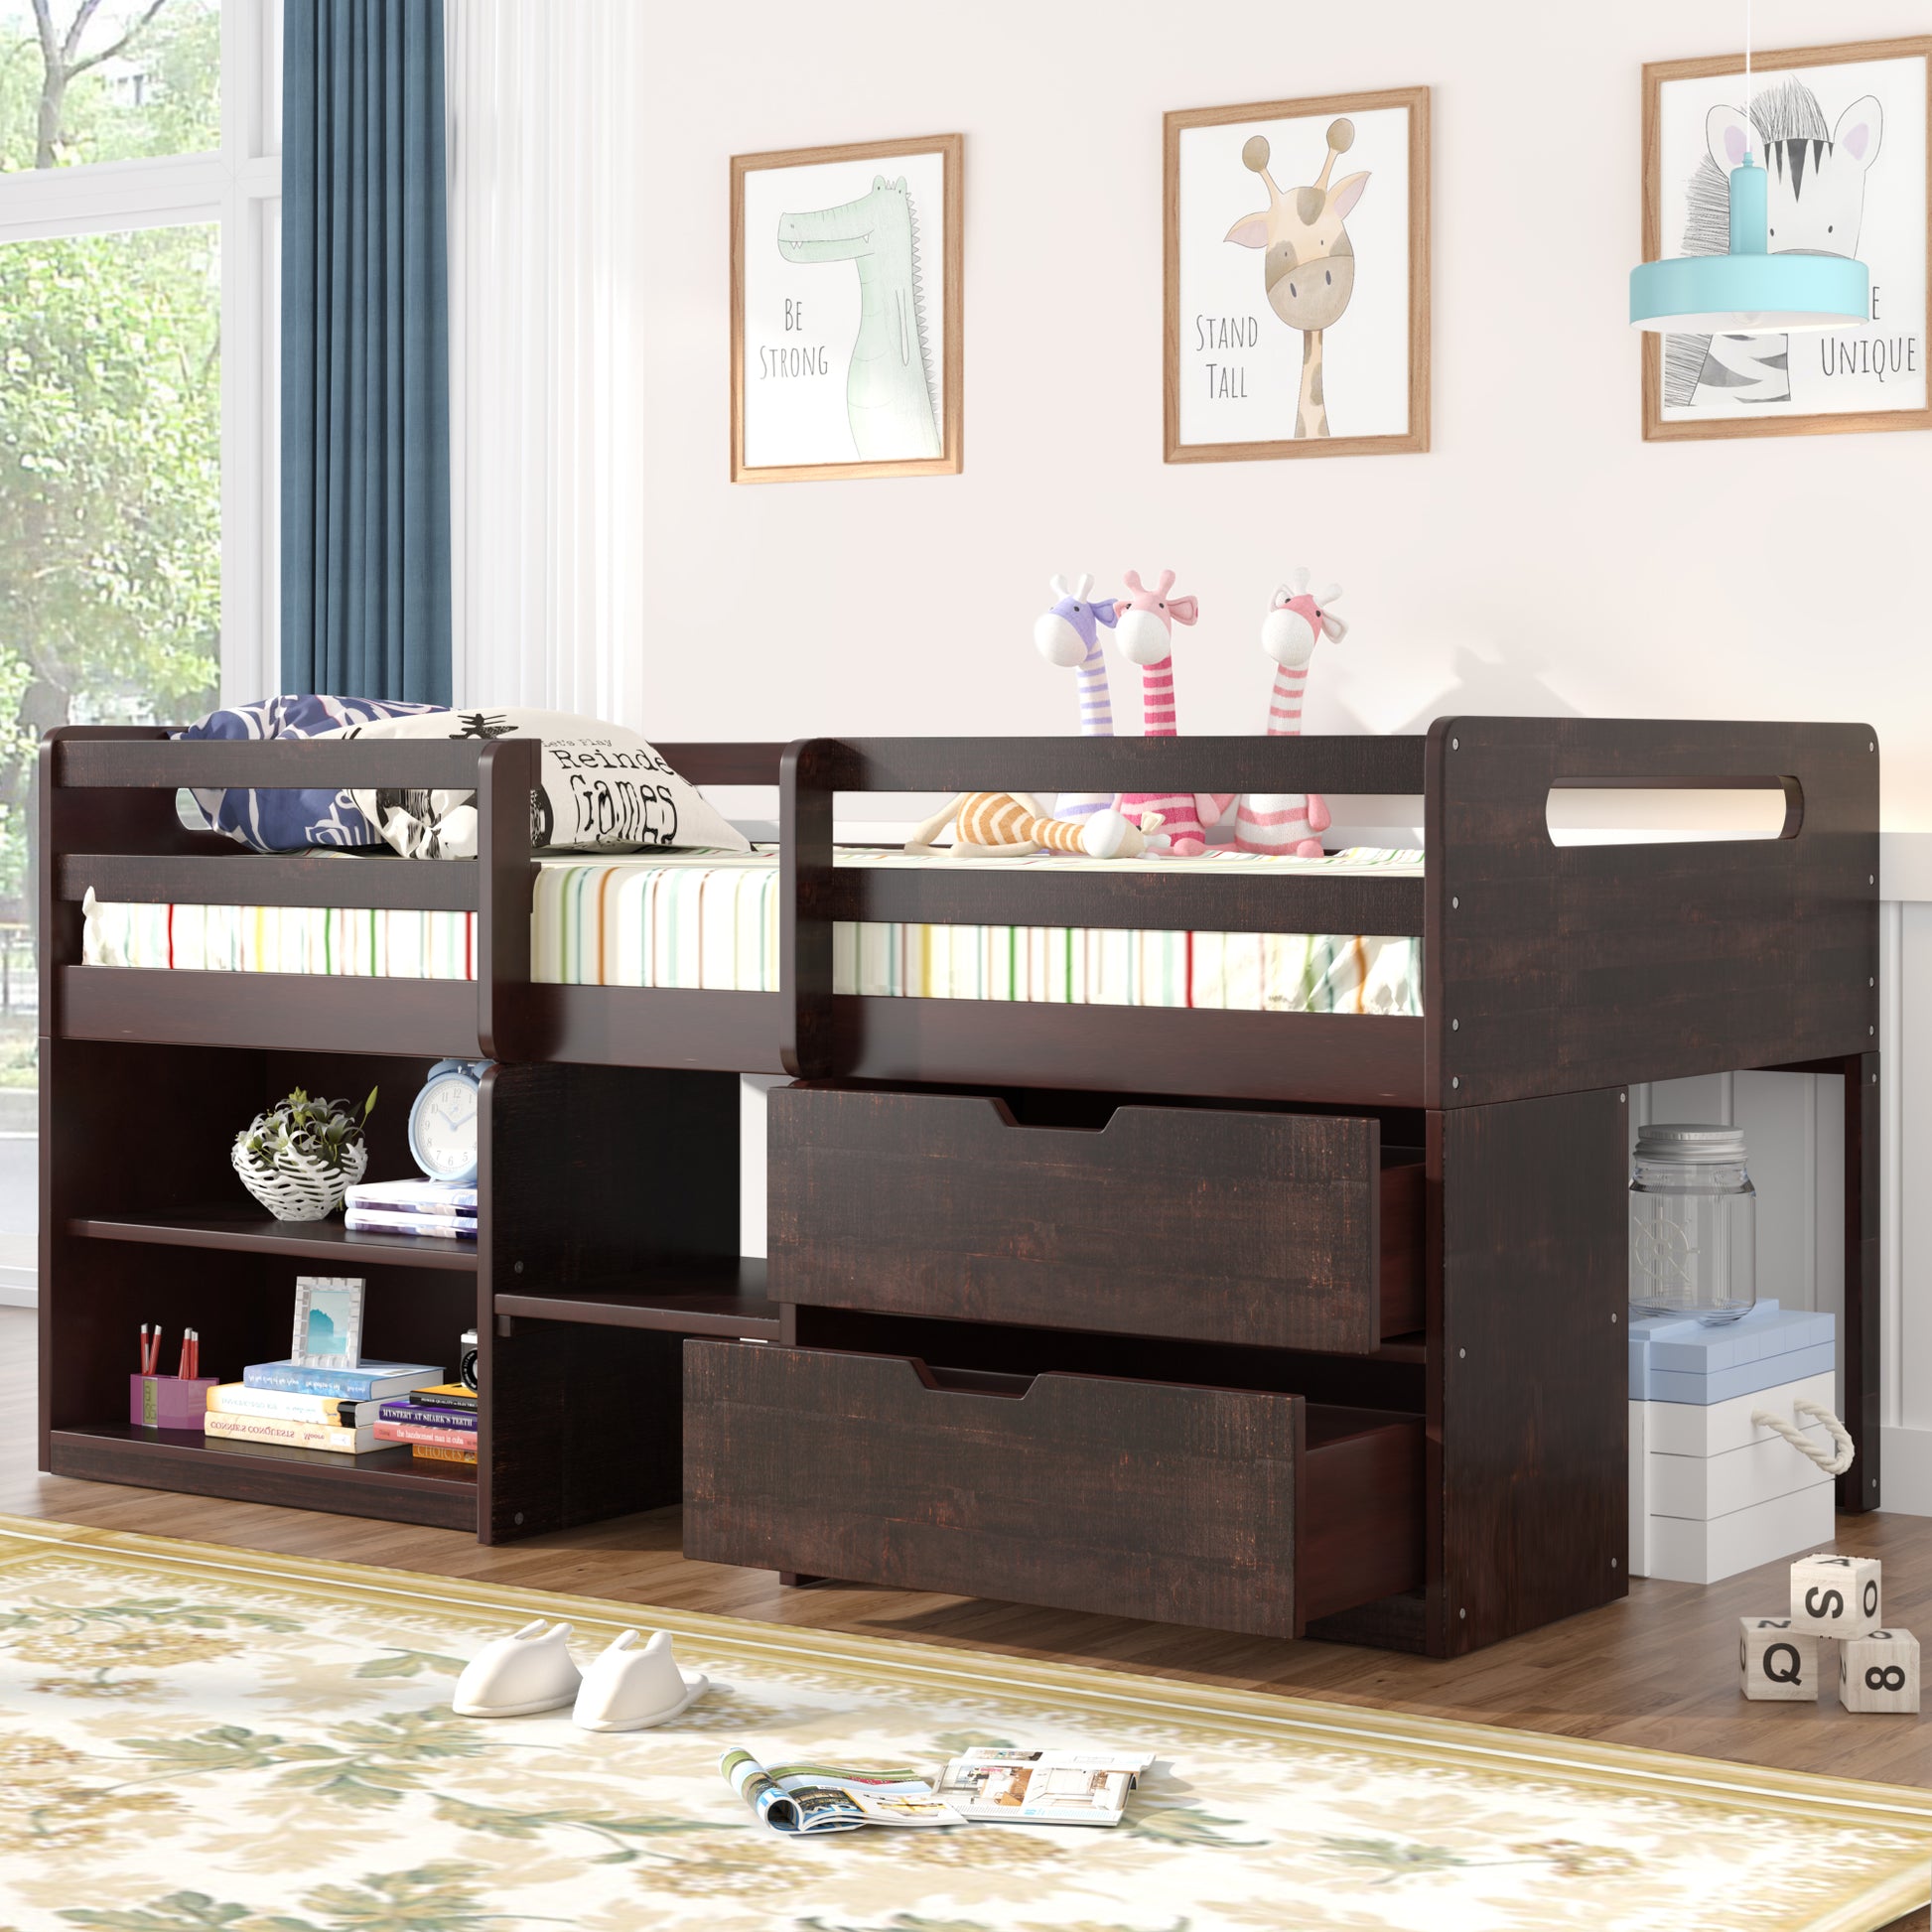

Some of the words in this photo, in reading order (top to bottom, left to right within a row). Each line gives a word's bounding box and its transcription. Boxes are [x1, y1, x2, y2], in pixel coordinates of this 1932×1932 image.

[784, 298, 803, 332] BE
[1871, 286, 1880, 320] E
[1196, 314, 1258, 351] STAND
[759, 345, 828, 380] STRONG
[1821, 337, 1916, 383] UNIQUE
[1205, 363, 1248, 399] TALL
[570, 773, 678, 844] Games
[1805, 1586, 1844, 1619] S
[1762, 1642, 1803, 1686] Q
[1864, 1665, 1906, 1692] 8
